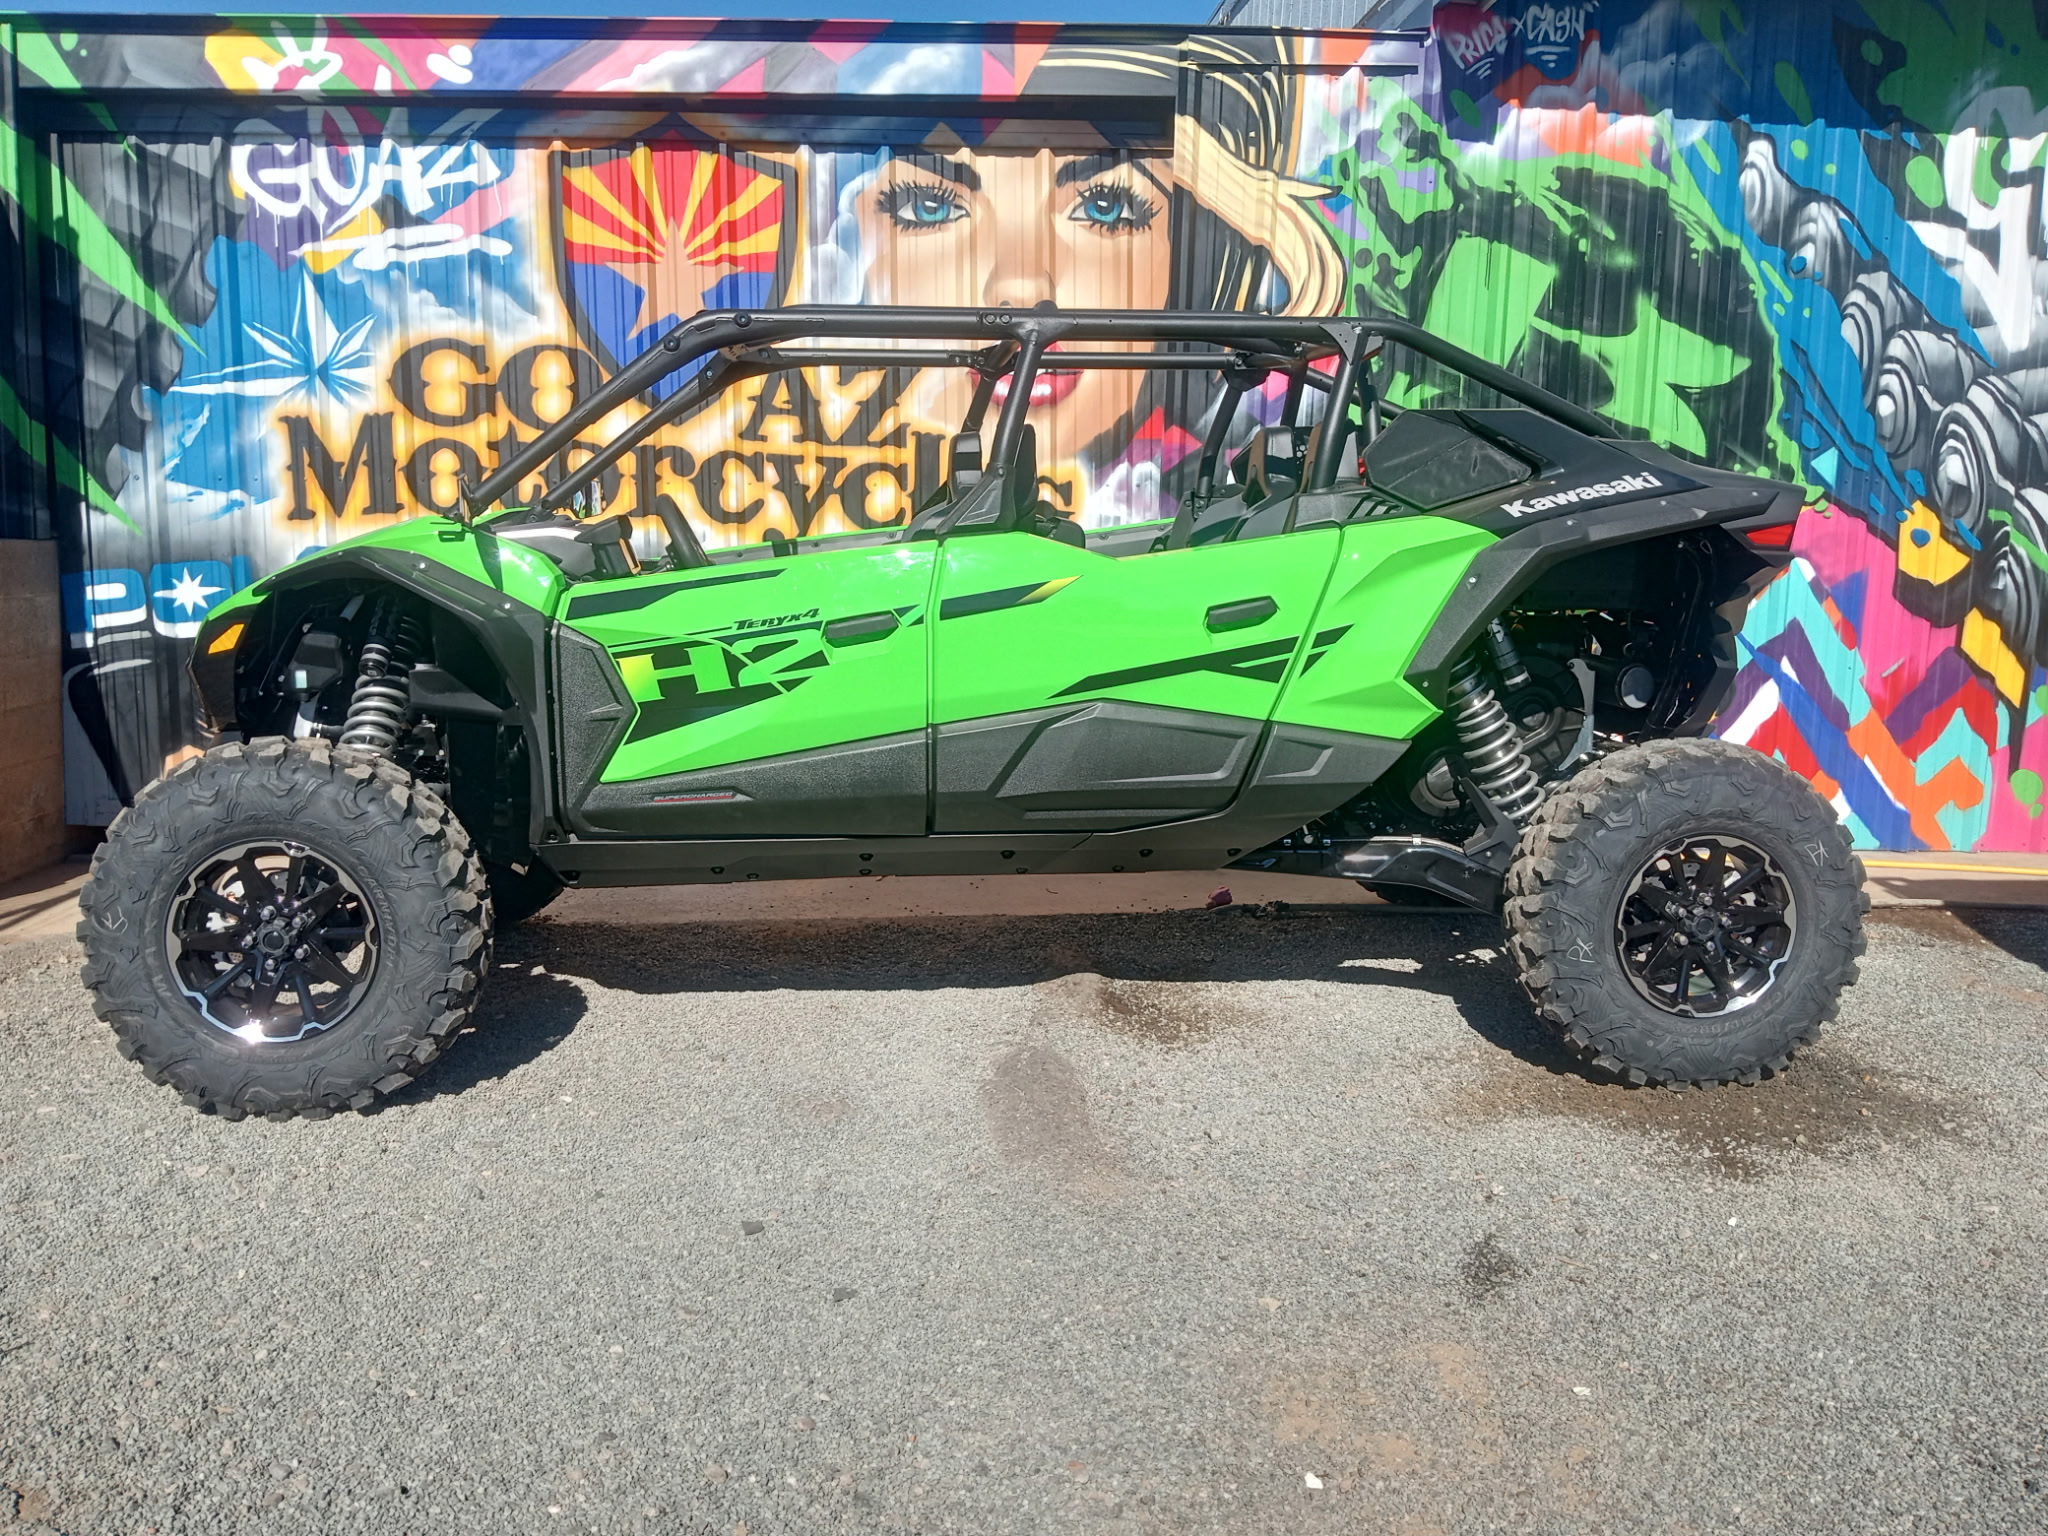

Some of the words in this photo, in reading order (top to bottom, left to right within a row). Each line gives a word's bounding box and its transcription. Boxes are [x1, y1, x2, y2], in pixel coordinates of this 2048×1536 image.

[386, 337, 605, 431] GO
[736, 366, 924, 449] AZ
[1500, 471, 1663, 518] Kawasaki
